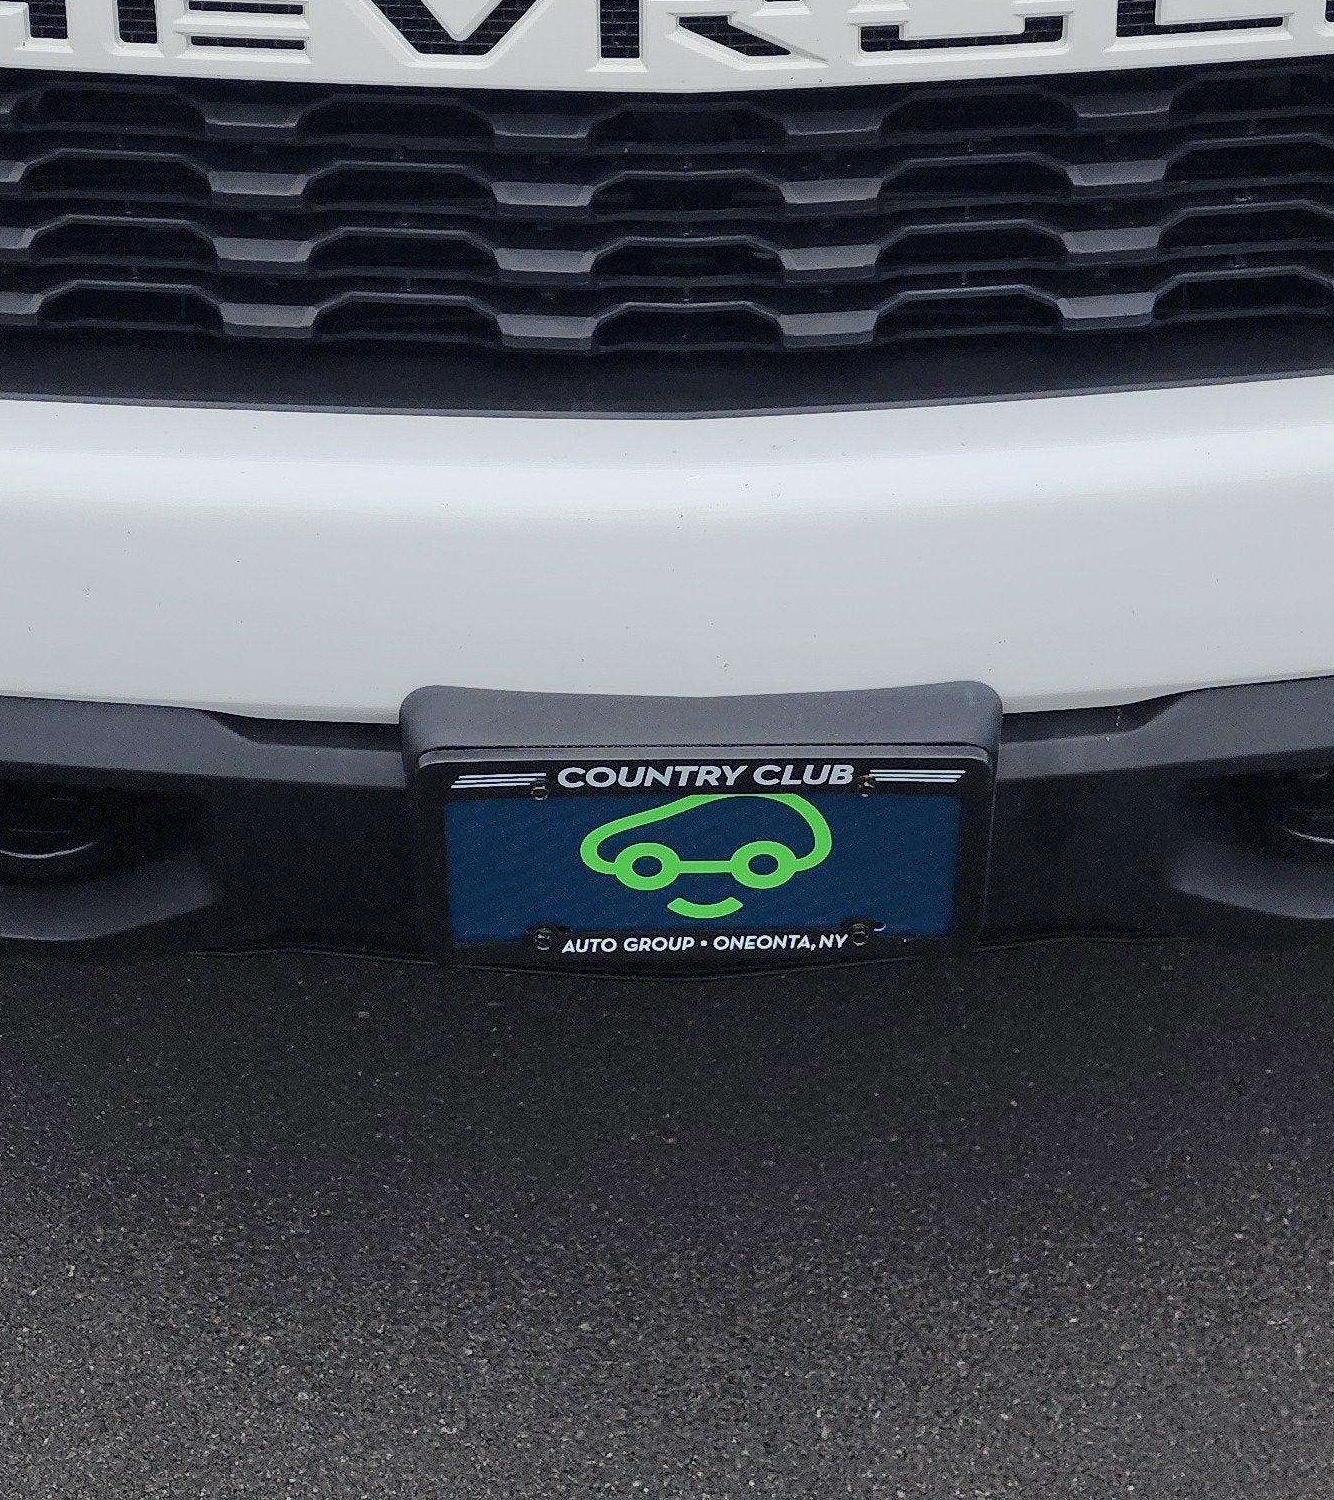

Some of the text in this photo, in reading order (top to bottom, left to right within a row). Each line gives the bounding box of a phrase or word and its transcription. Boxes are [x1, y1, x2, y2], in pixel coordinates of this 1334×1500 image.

[557, 763, 855, 788] COUNTRY CLUB
[561, 937, 617, 954] AUTO
[623, 936, 695, 952] GROUP
